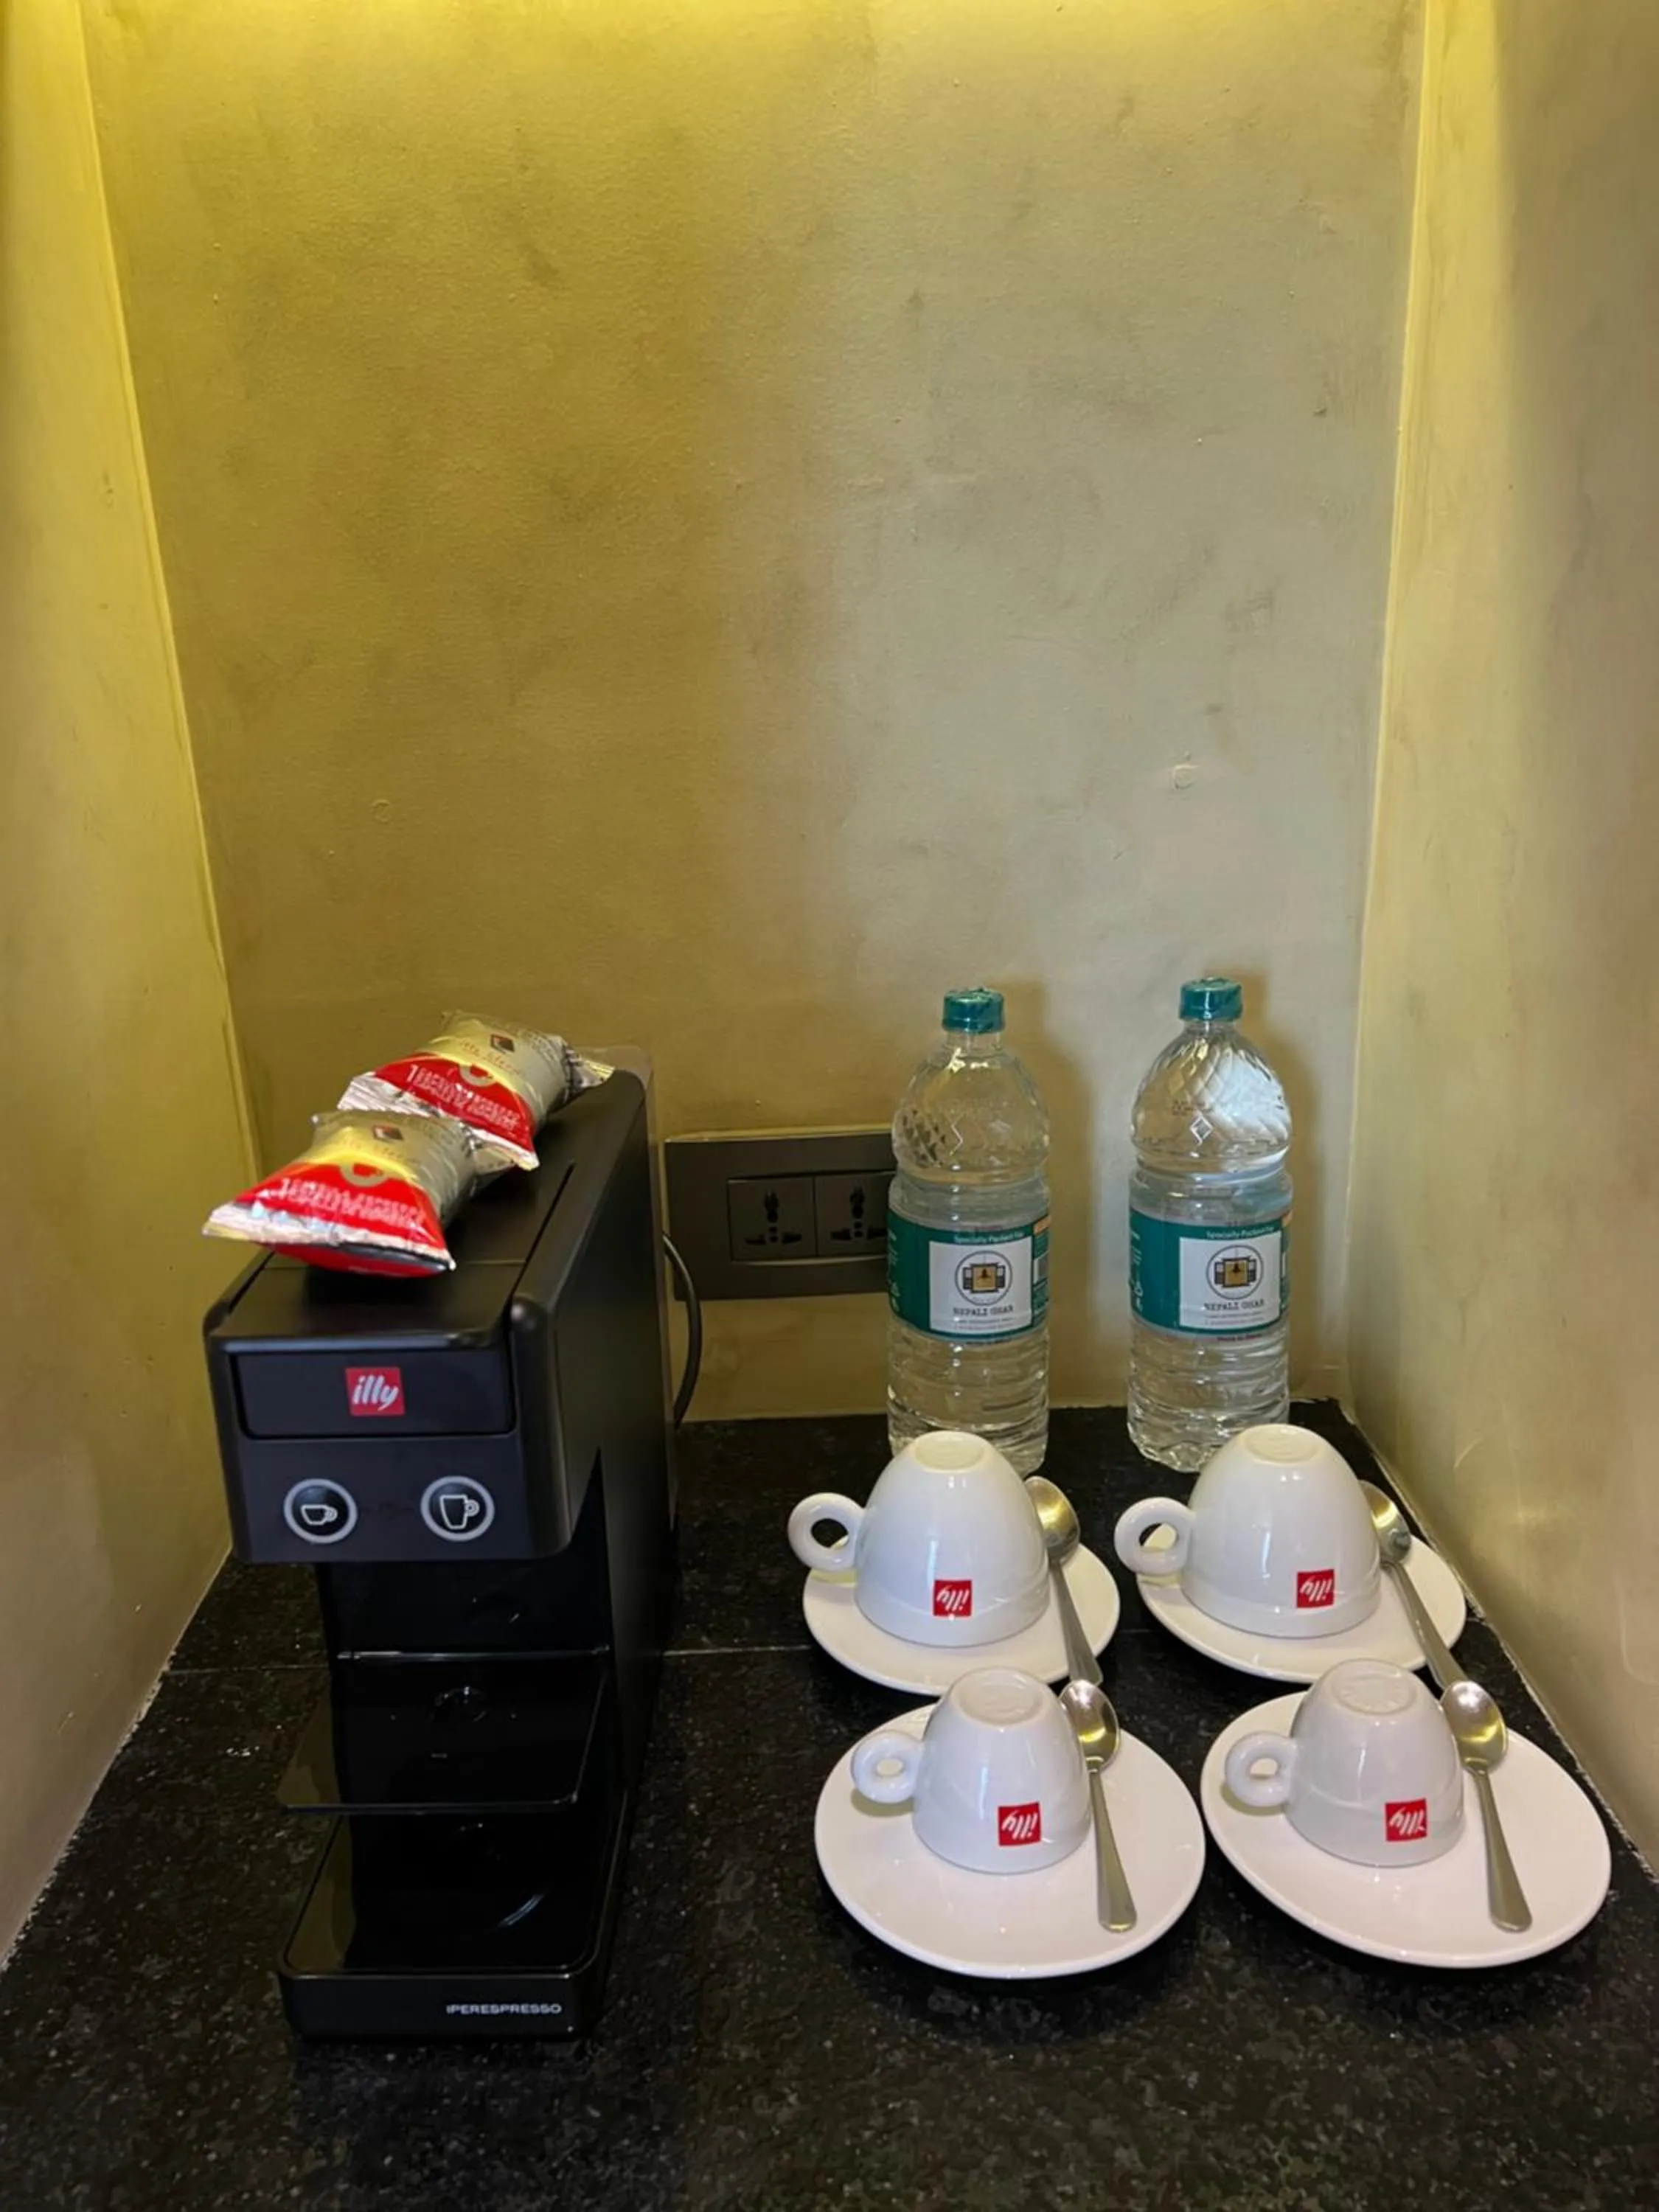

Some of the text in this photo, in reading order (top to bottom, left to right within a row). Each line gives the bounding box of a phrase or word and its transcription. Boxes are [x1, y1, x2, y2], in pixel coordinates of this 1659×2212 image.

[352, 1374, 399, 1411] illy
[936, 1584, 970, 1611] illy
[1300, 1575, 1332, 1602] illy
[1001, 1809, 1037, 1840] illy
[1388, 1806, 1425, 1835] illy
